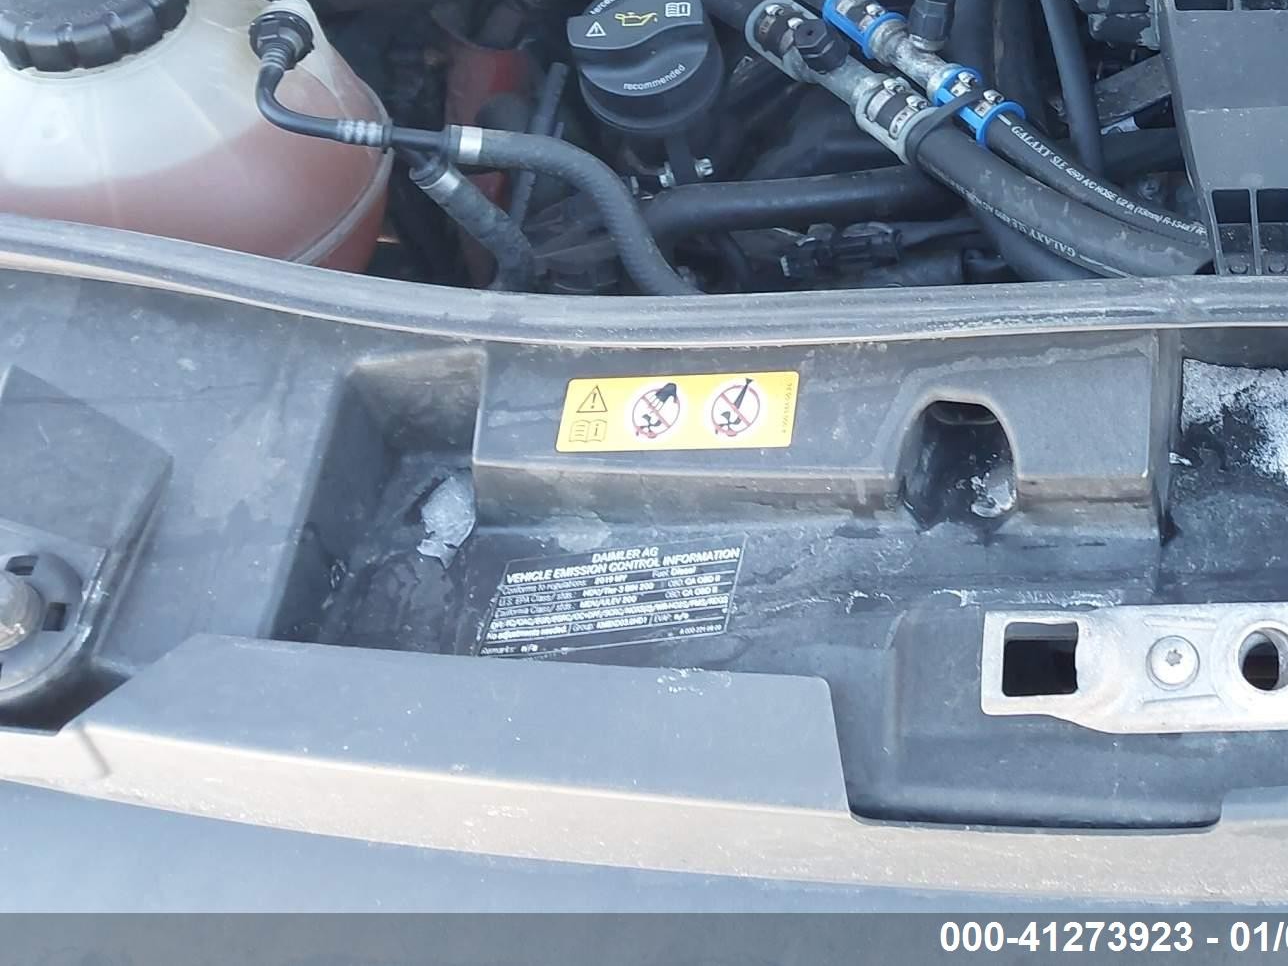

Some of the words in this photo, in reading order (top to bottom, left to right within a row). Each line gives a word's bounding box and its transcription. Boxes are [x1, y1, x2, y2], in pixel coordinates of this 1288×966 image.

[623, 63, 686, 91] recommended
[1011, 125, 1051, 157] GALAXY
[1094, 184, 1118, 202] HOSE
[1029, 228, 1076, 259] GALAXY
[506, 570, 553, 584] VEHICLE
[553, 563, 607, 580] EMISSION
[608, 557, 661, 572] CONTROL
[663, 547, 740, 566] INFORMATION
[592, 548, 641, 563] DAIMLER
[642, 546, 659, 558] AG
[670, 565, 697, 577] Diesel
